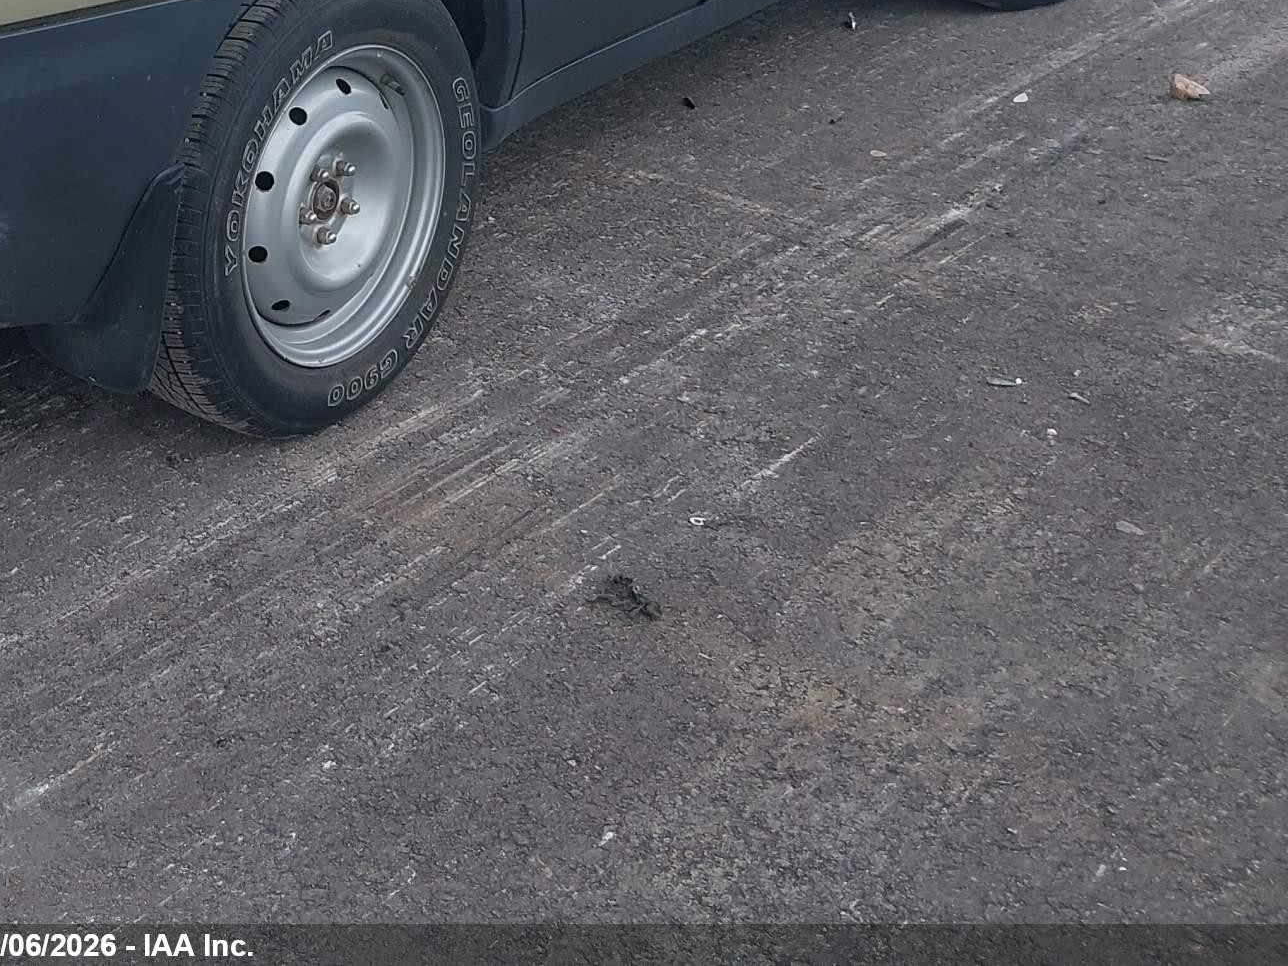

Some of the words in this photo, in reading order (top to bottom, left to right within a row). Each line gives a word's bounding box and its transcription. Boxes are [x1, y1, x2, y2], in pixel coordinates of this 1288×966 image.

[225, 30, 333, 276] YOKOHAMA
[402, 77, 477, 348] GEOLANDAR
[327, 349, 398, 407] G900
